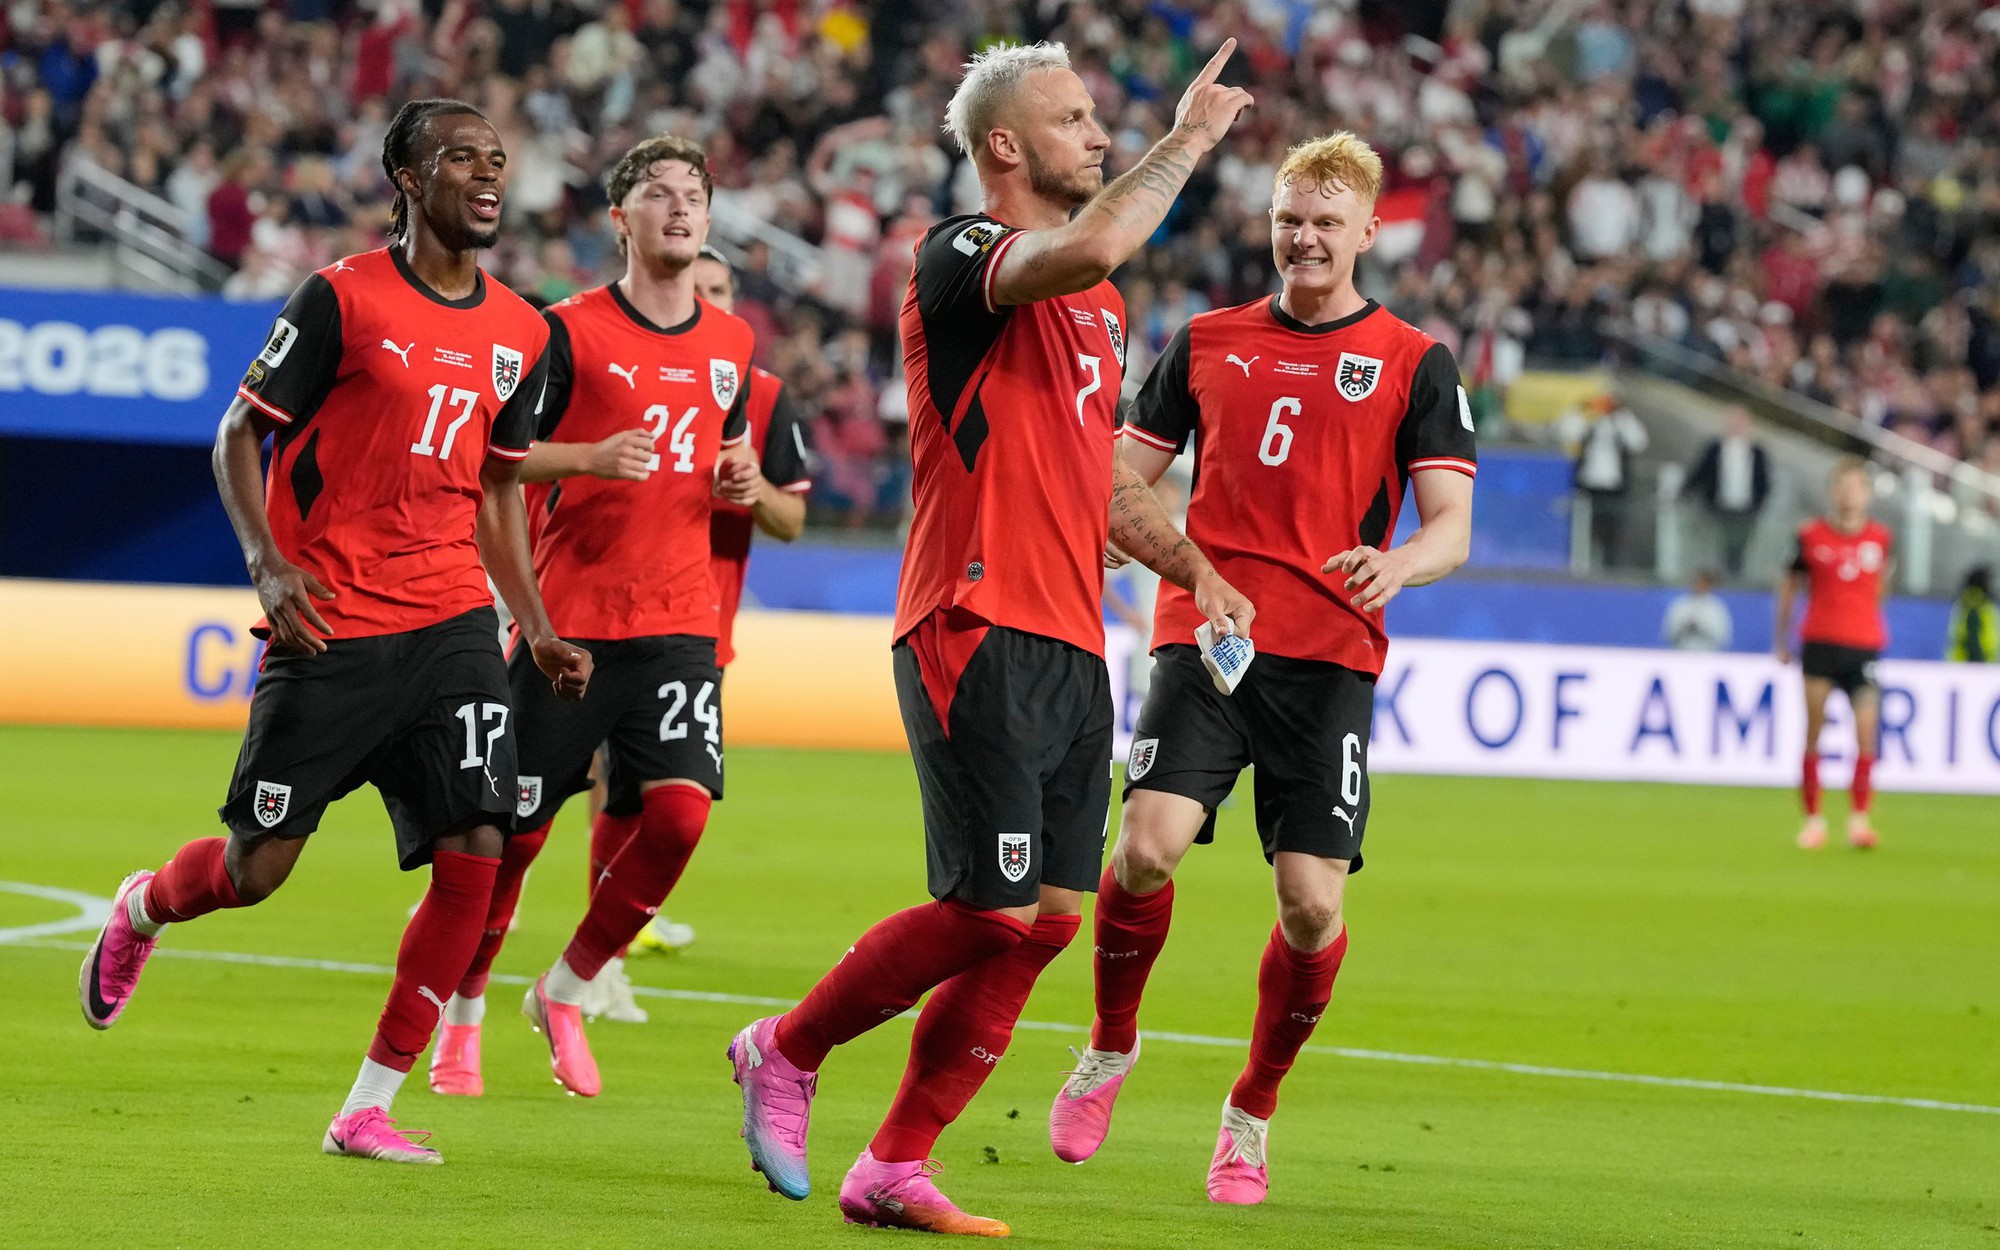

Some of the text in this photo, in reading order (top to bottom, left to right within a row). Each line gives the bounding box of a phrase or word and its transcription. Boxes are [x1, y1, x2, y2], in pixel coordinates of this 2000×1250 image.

[410, 383, 481, 461] 17
[1076, 352, 1102, 427] 7
[643, 404, 700, 474] 24
[1258, 396, 1303, 467] 6
[1209, 644, 1232, 677] FOOTBALL
[1216, 636, 1241, 671] UNITES
[454, 702, 510, 771] 17
[658, 680, 720, 744] 24
[1466, 667, 1588, 750] OF
[1628, 676, 2000, 764] AMRI
[1341, 732, 1362, 807] 6
